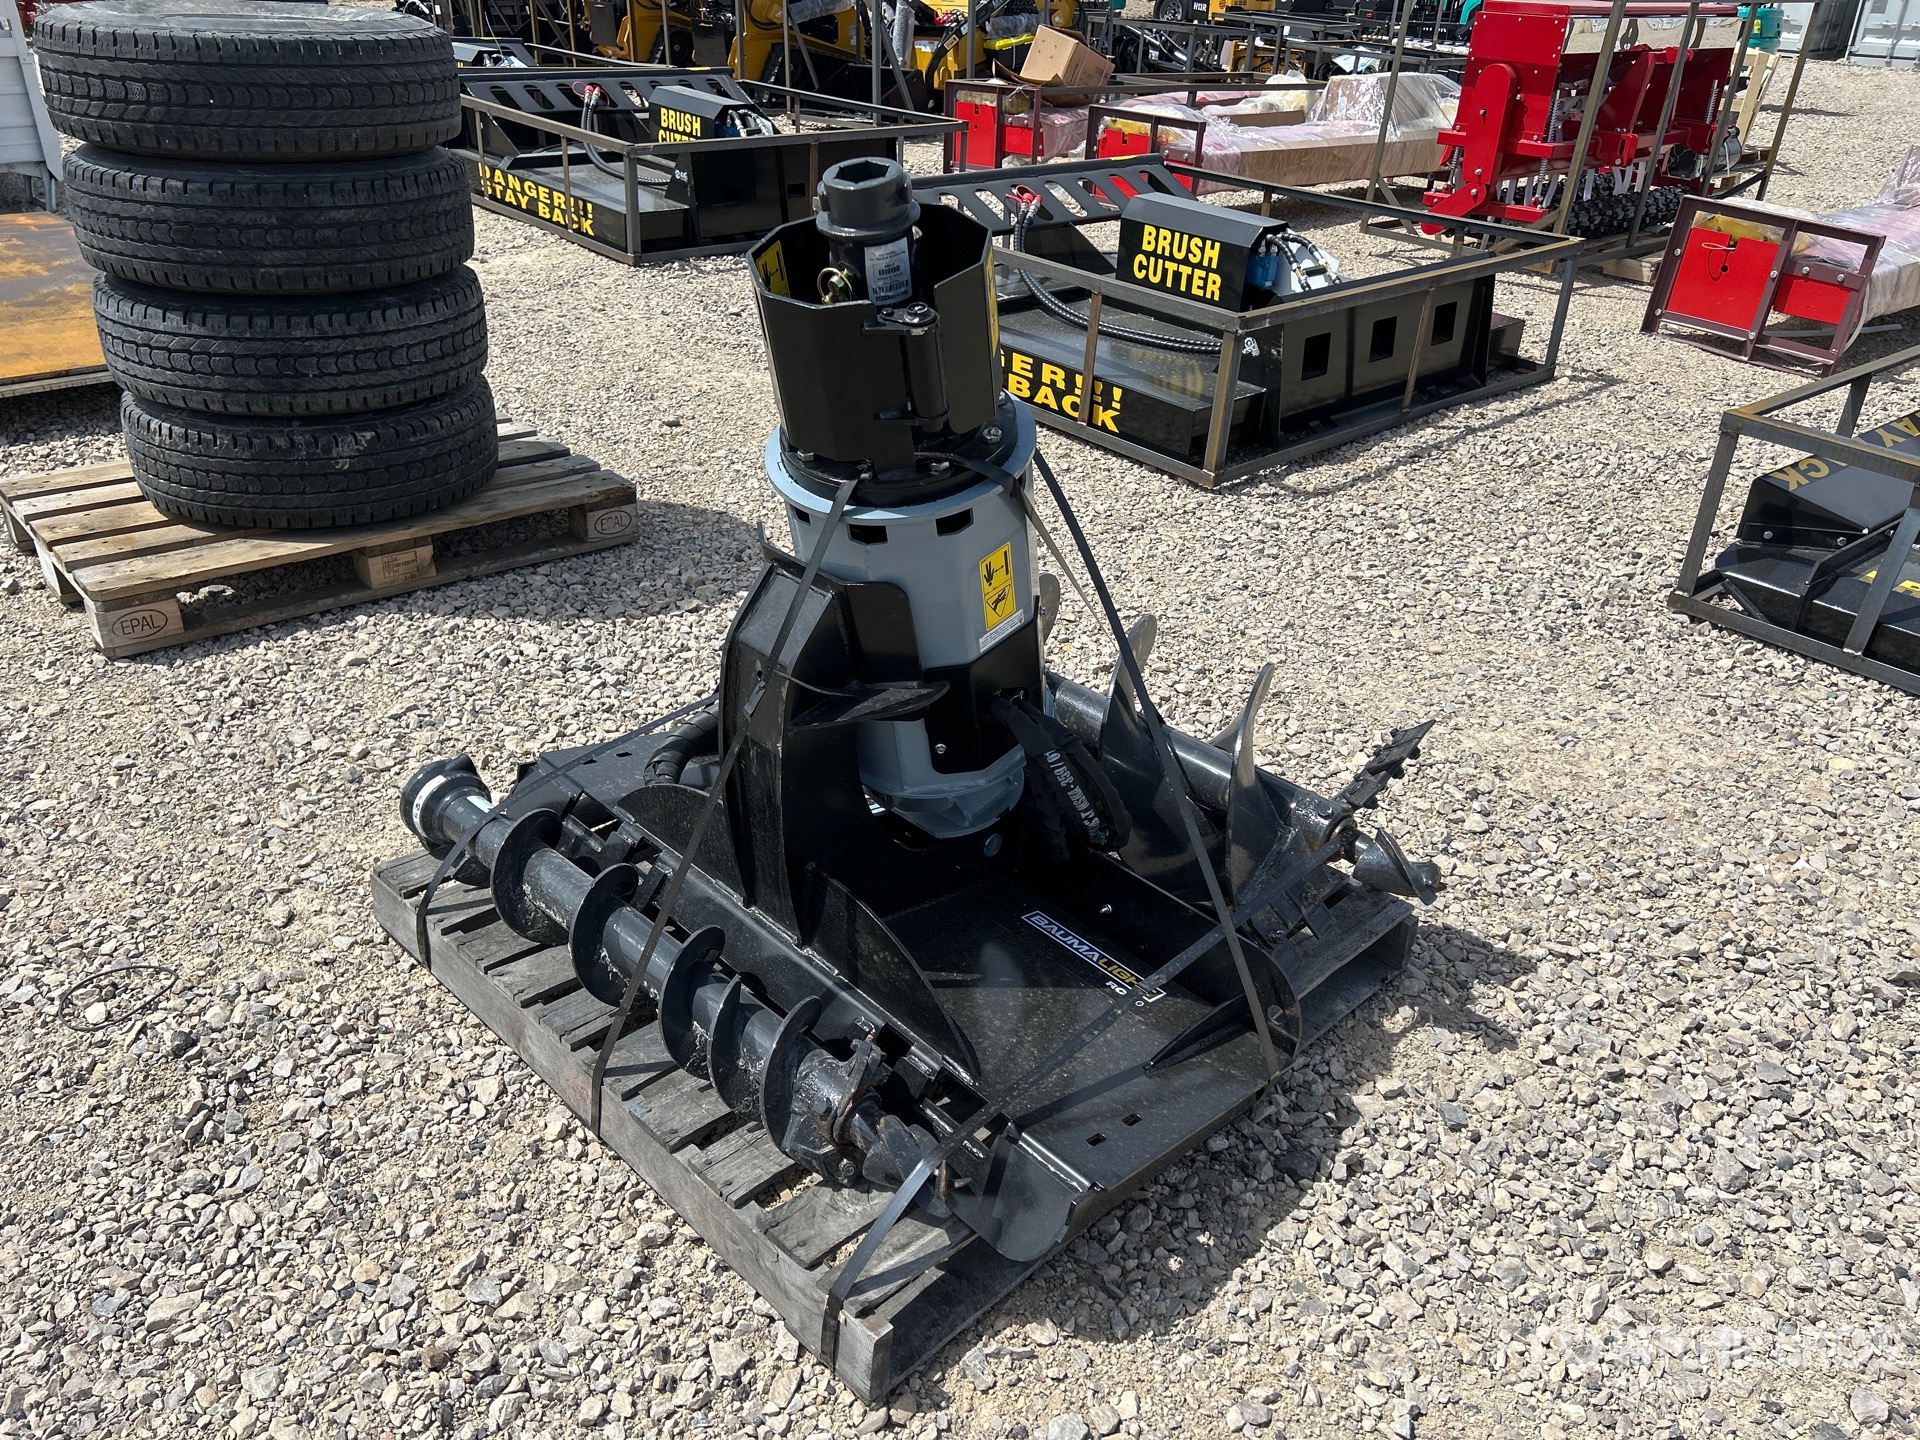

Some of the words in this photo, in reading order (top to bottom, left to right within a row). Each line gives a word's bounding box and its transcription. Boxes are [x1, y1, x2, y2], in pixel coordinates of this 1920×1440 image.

[660, 107, 701, 137] BRUSH
[481, 179, 530, 209] STAY
[538, 201, 595, 236] BACK
[1142, 224, 1221, 269] BRUSH
[1133, 253, 1222, 302] CUTTER
[1001, 348, 1123, 410] ER!!!
[1008, 372, 1121, 434] BACK
[1874, 411, 1920, 448] AY
[120, 614, 162, 635] EPAL
[1030, 915, 1156, 994] BAUMALIGH
